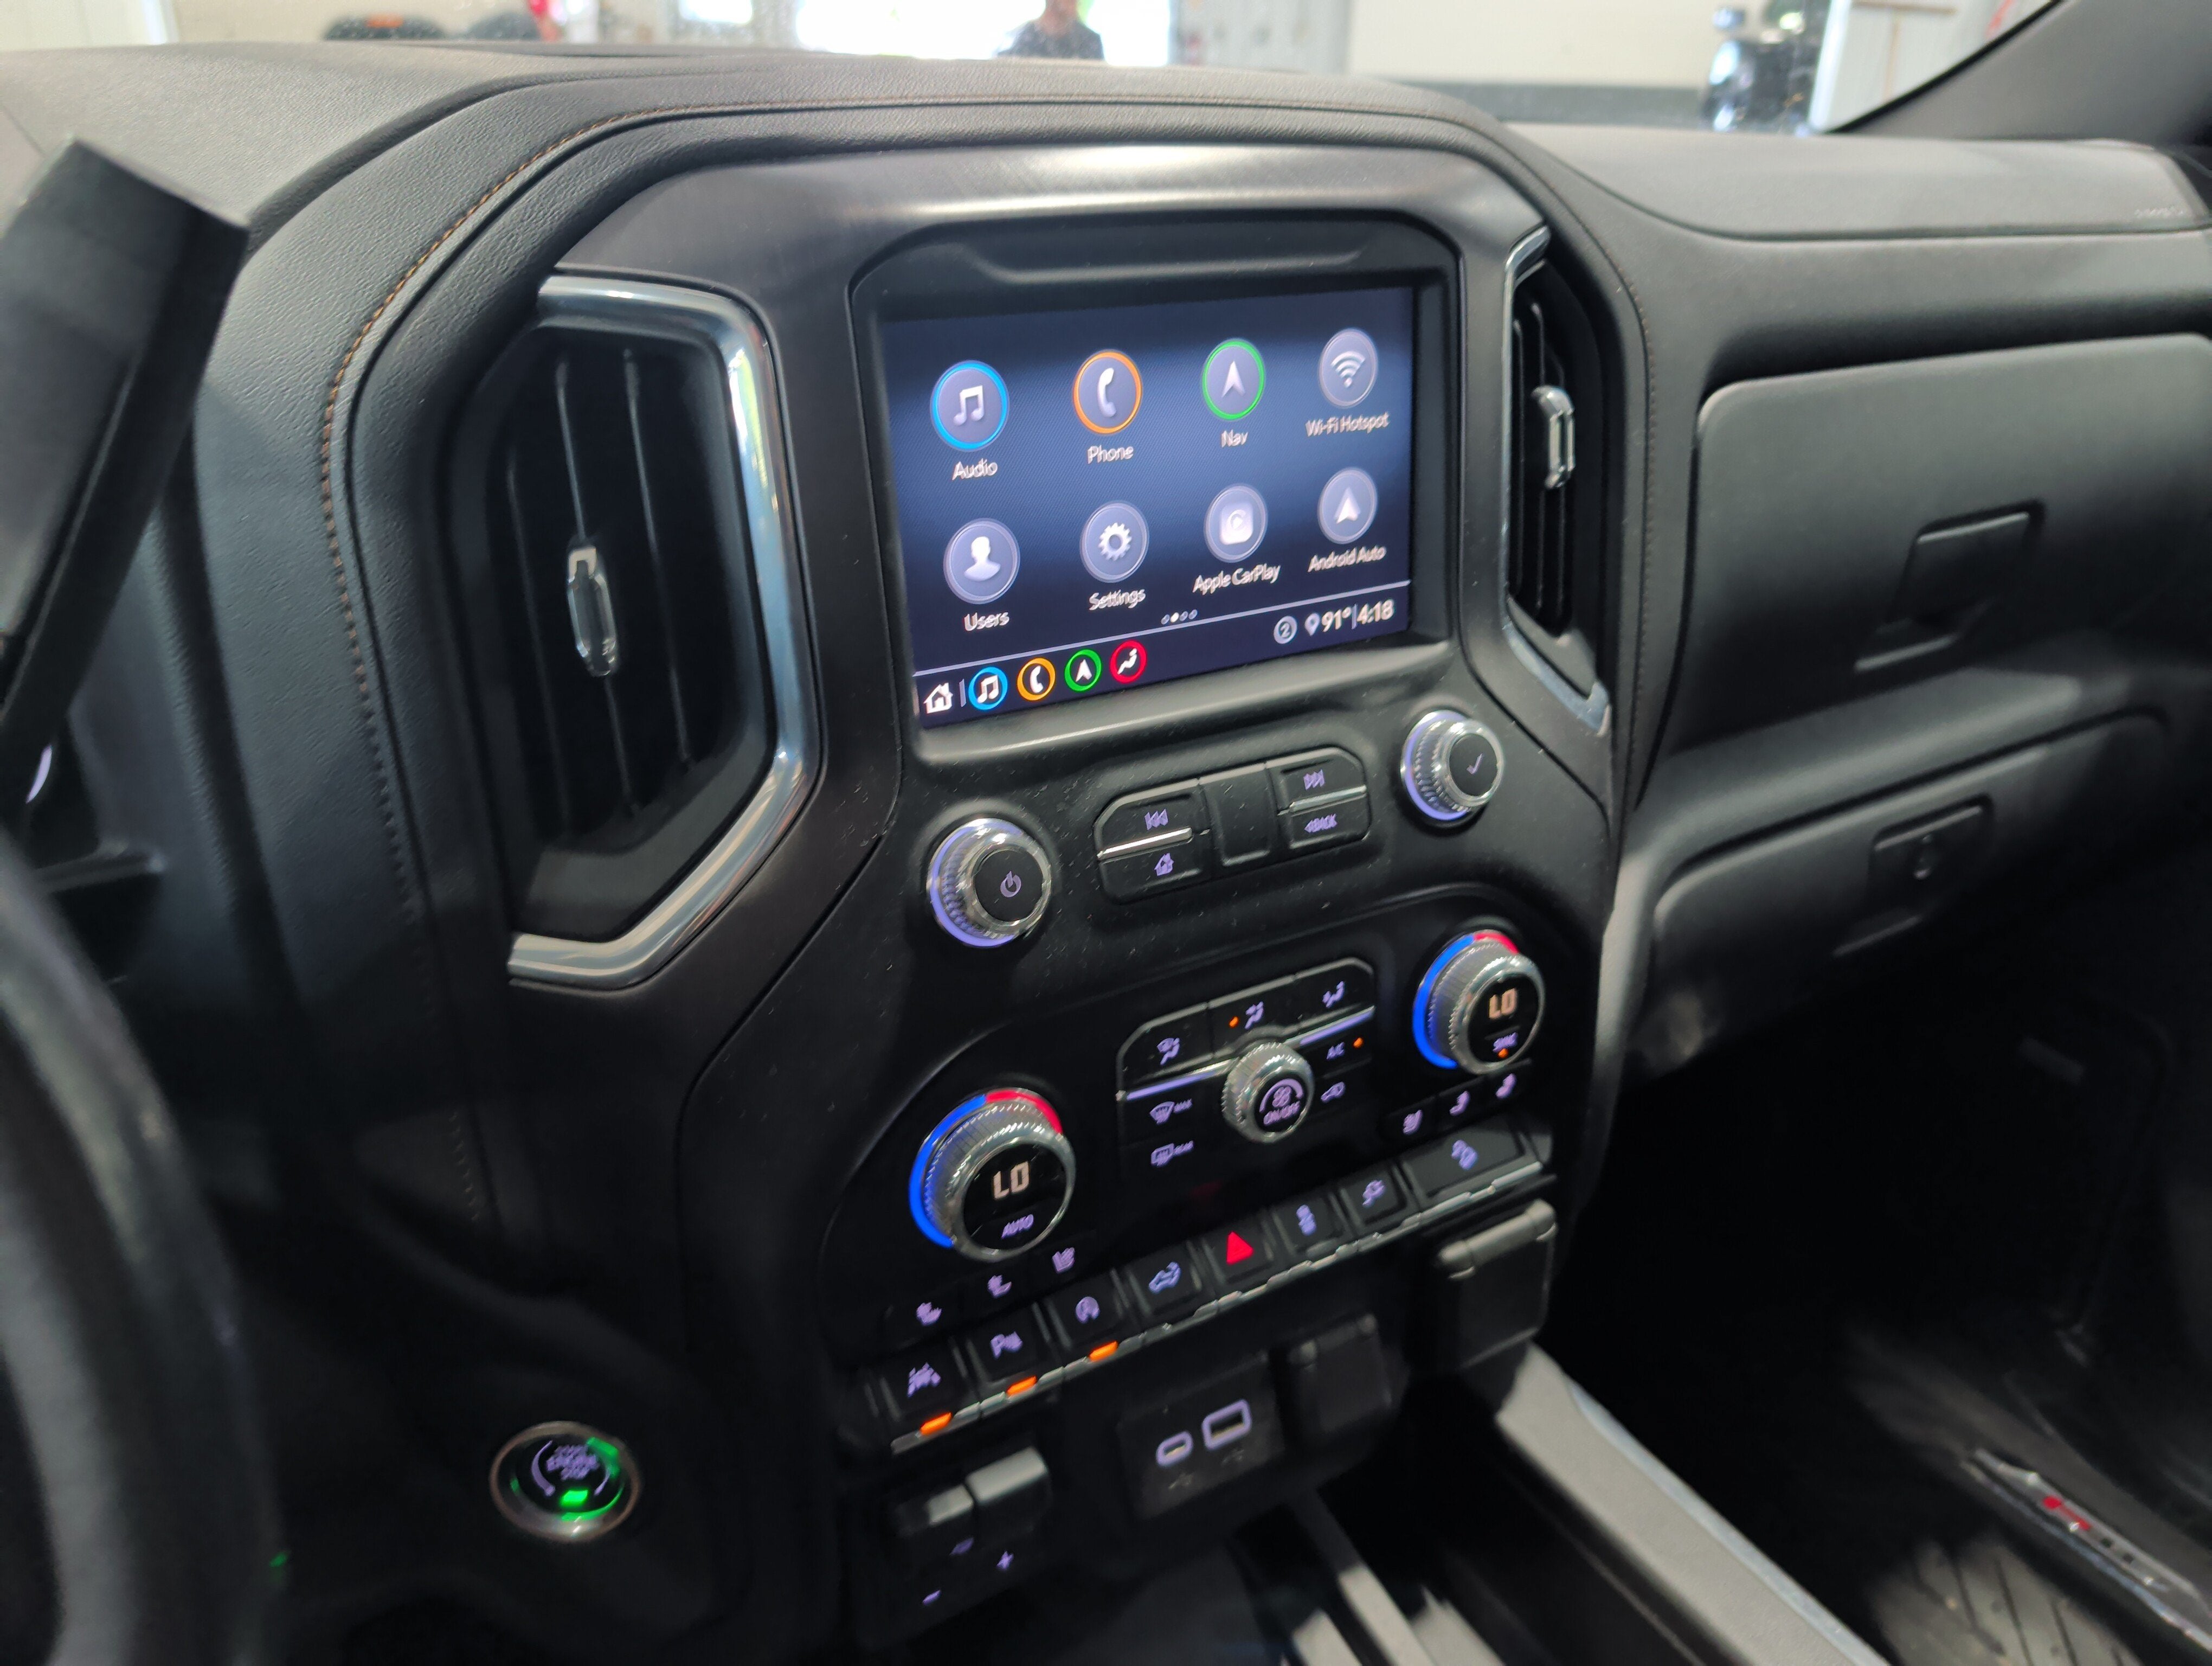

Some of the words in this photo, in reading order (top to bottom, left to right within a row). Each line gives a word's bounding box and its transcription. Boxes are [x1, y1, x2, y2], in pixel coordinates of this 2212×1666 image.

[1306, 416, 1339, 437] Wi-Fi
[1340, 412, 1390, 434] Hotspot
[1221, 429, 1249, 448] Nav
[1086, 445, 1134, 464] Phone
[951, 458, 998, 481] Audio
[1308, 548, 1355, 573] Android
[1356, 544, 1387, 565] Auto
[1192, 570, 1231, 595] Apple
[1231, 562, 1281, 584] CarPlay
[1089, 589, 1146, 611] Settings
[963, 612, 1010, 632] Users
[1356, 599, 1394, 625] 4:18
